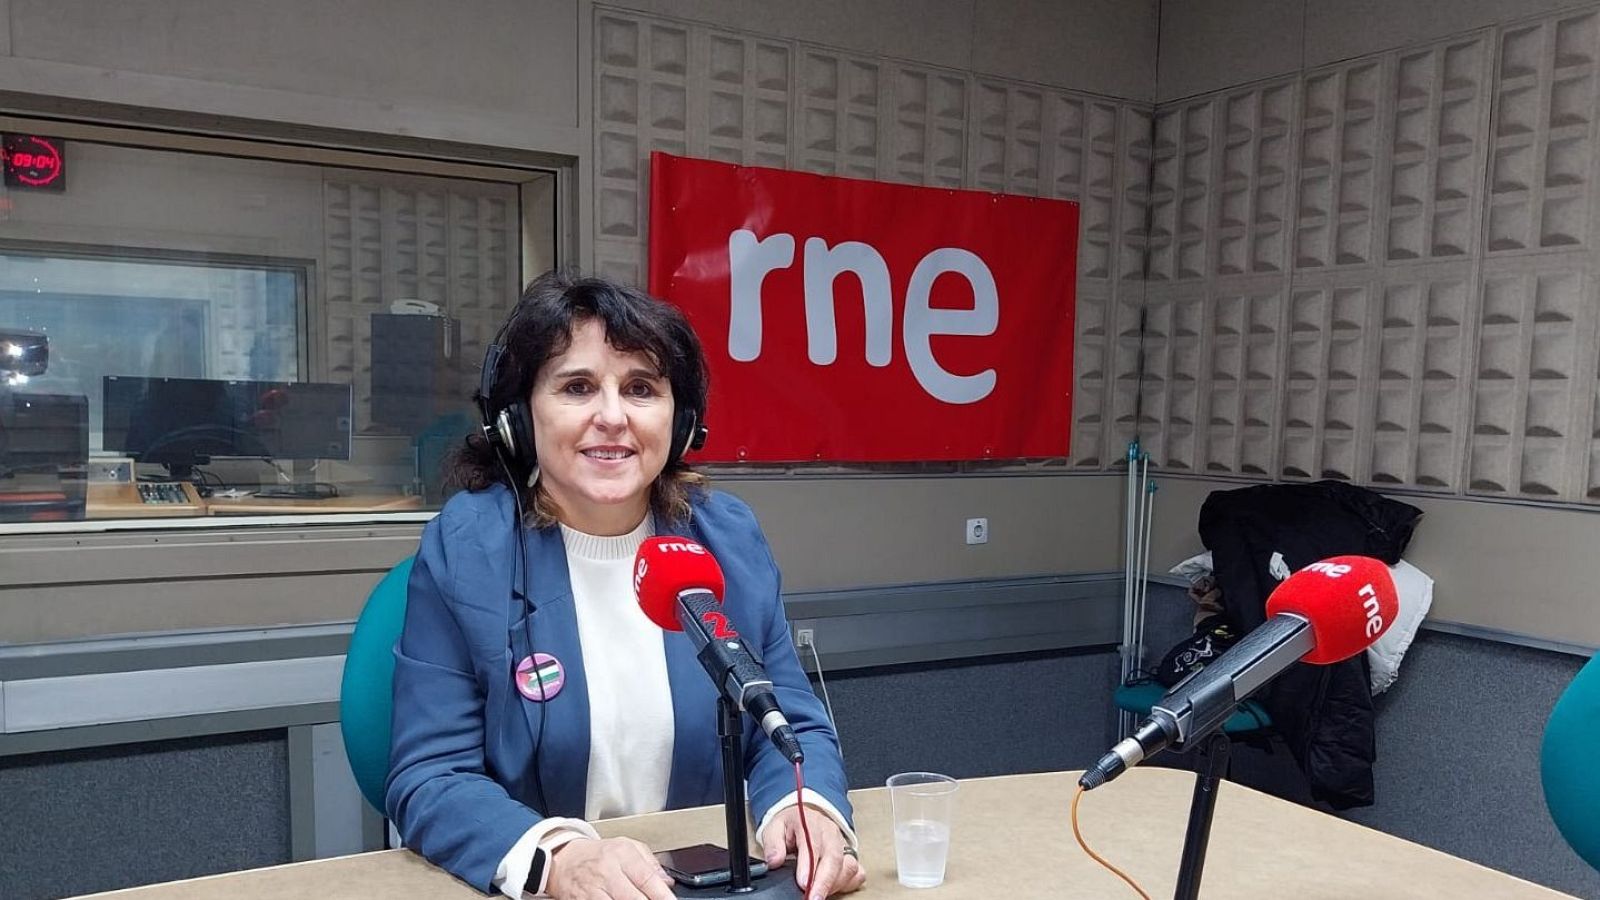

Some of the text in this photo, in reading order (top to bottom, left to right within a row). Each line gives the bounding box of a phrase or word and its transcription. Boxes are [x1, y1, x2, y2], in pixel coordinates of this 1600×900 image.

[728, 229, 999, 404] rne
[658, 543, 705, 554] rne
[703, 611, 739, 640] 2
[1358, 583, 1383, 638] rne
